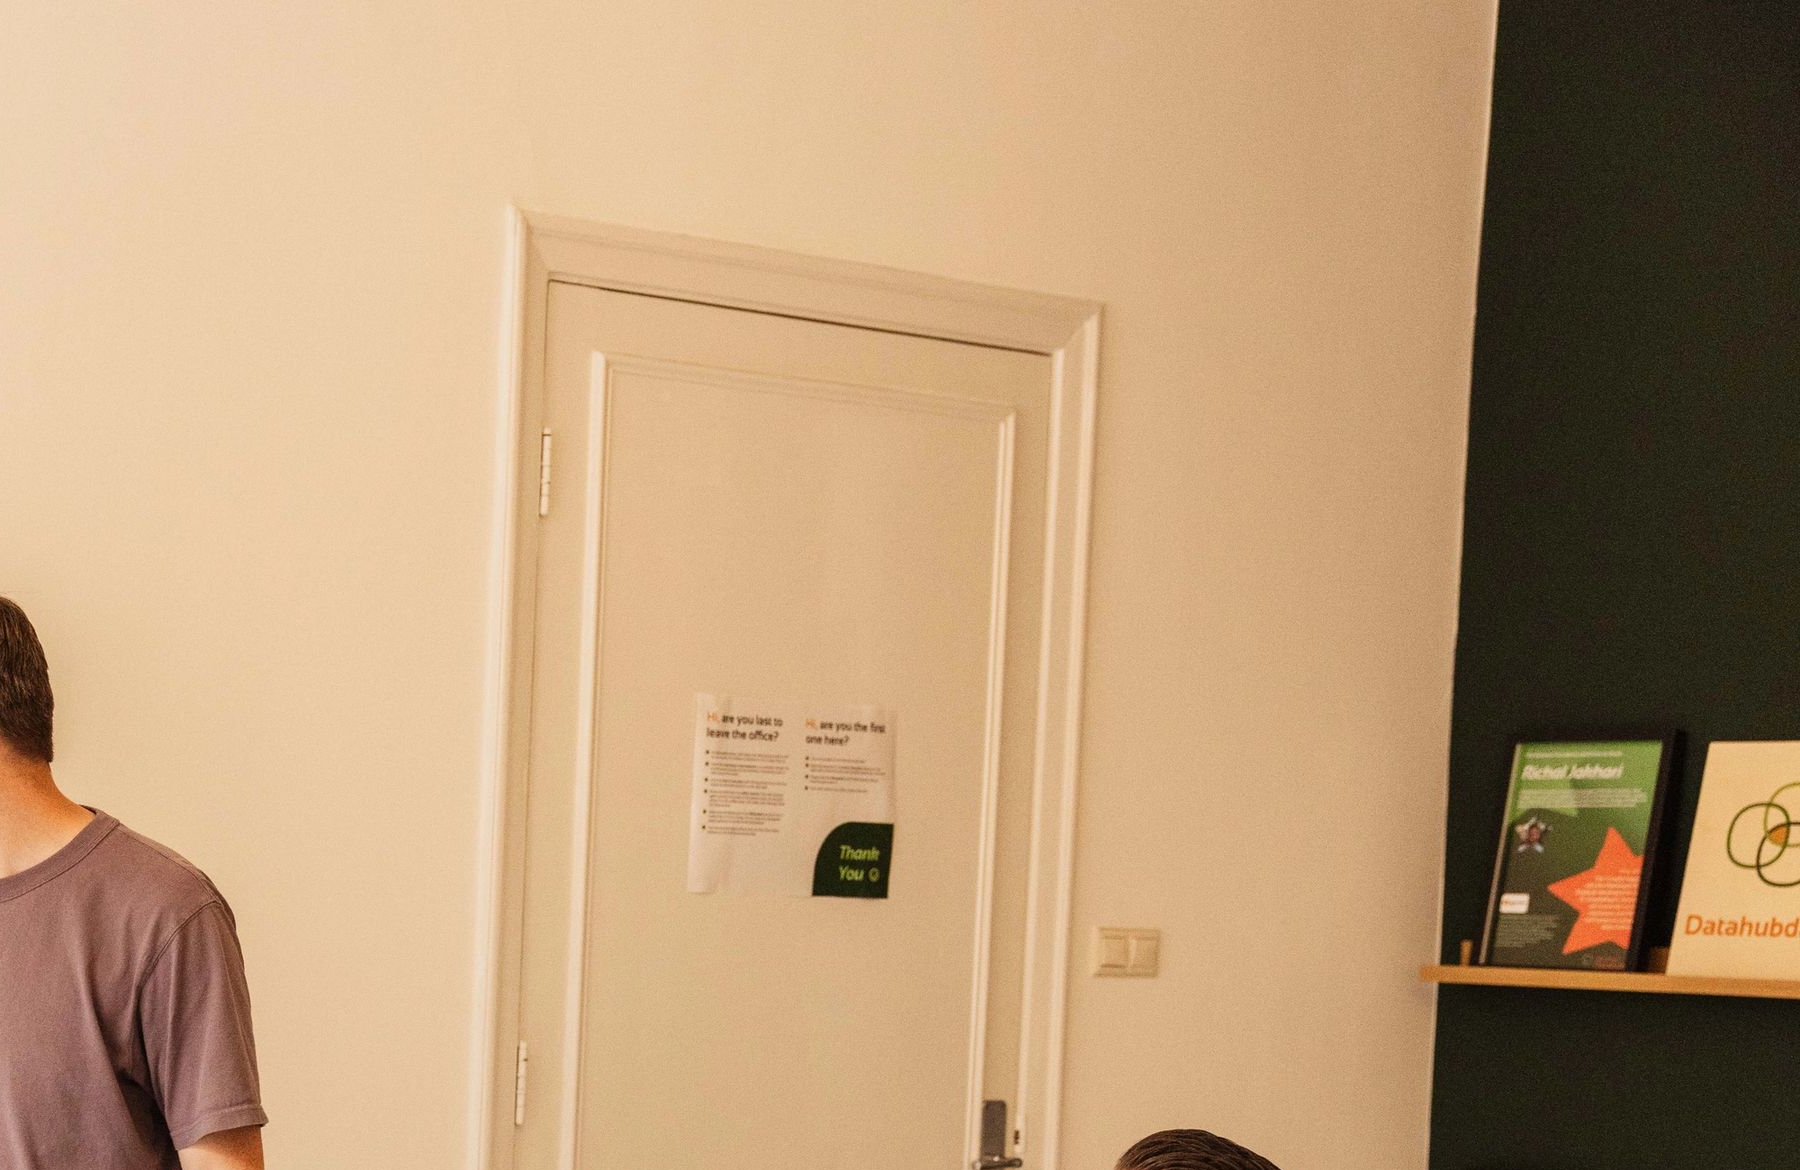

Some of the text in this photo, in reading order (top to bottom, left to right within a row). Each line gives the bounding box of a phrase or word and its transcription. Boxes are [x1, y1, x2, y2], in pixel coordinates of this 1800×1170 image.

[722, 714, 734, 723] are
[737, 715, 753, 727] you
[755, 714, 772, 726] last
[773, 717, 783, 727] to
[820, 722, 833, 731] are
[835, 722, 851, 733] you
[853, 721, 868, 732] the
[870, 721, 886, 733] first
[706, 728, 779, 742] leave the office?
[805, 735, 849, 746] one here?
[839, 845, 880, 860] Thank
[837, 865, 864, 882] You
[1684, 914, 1800, 938] Datahubd
